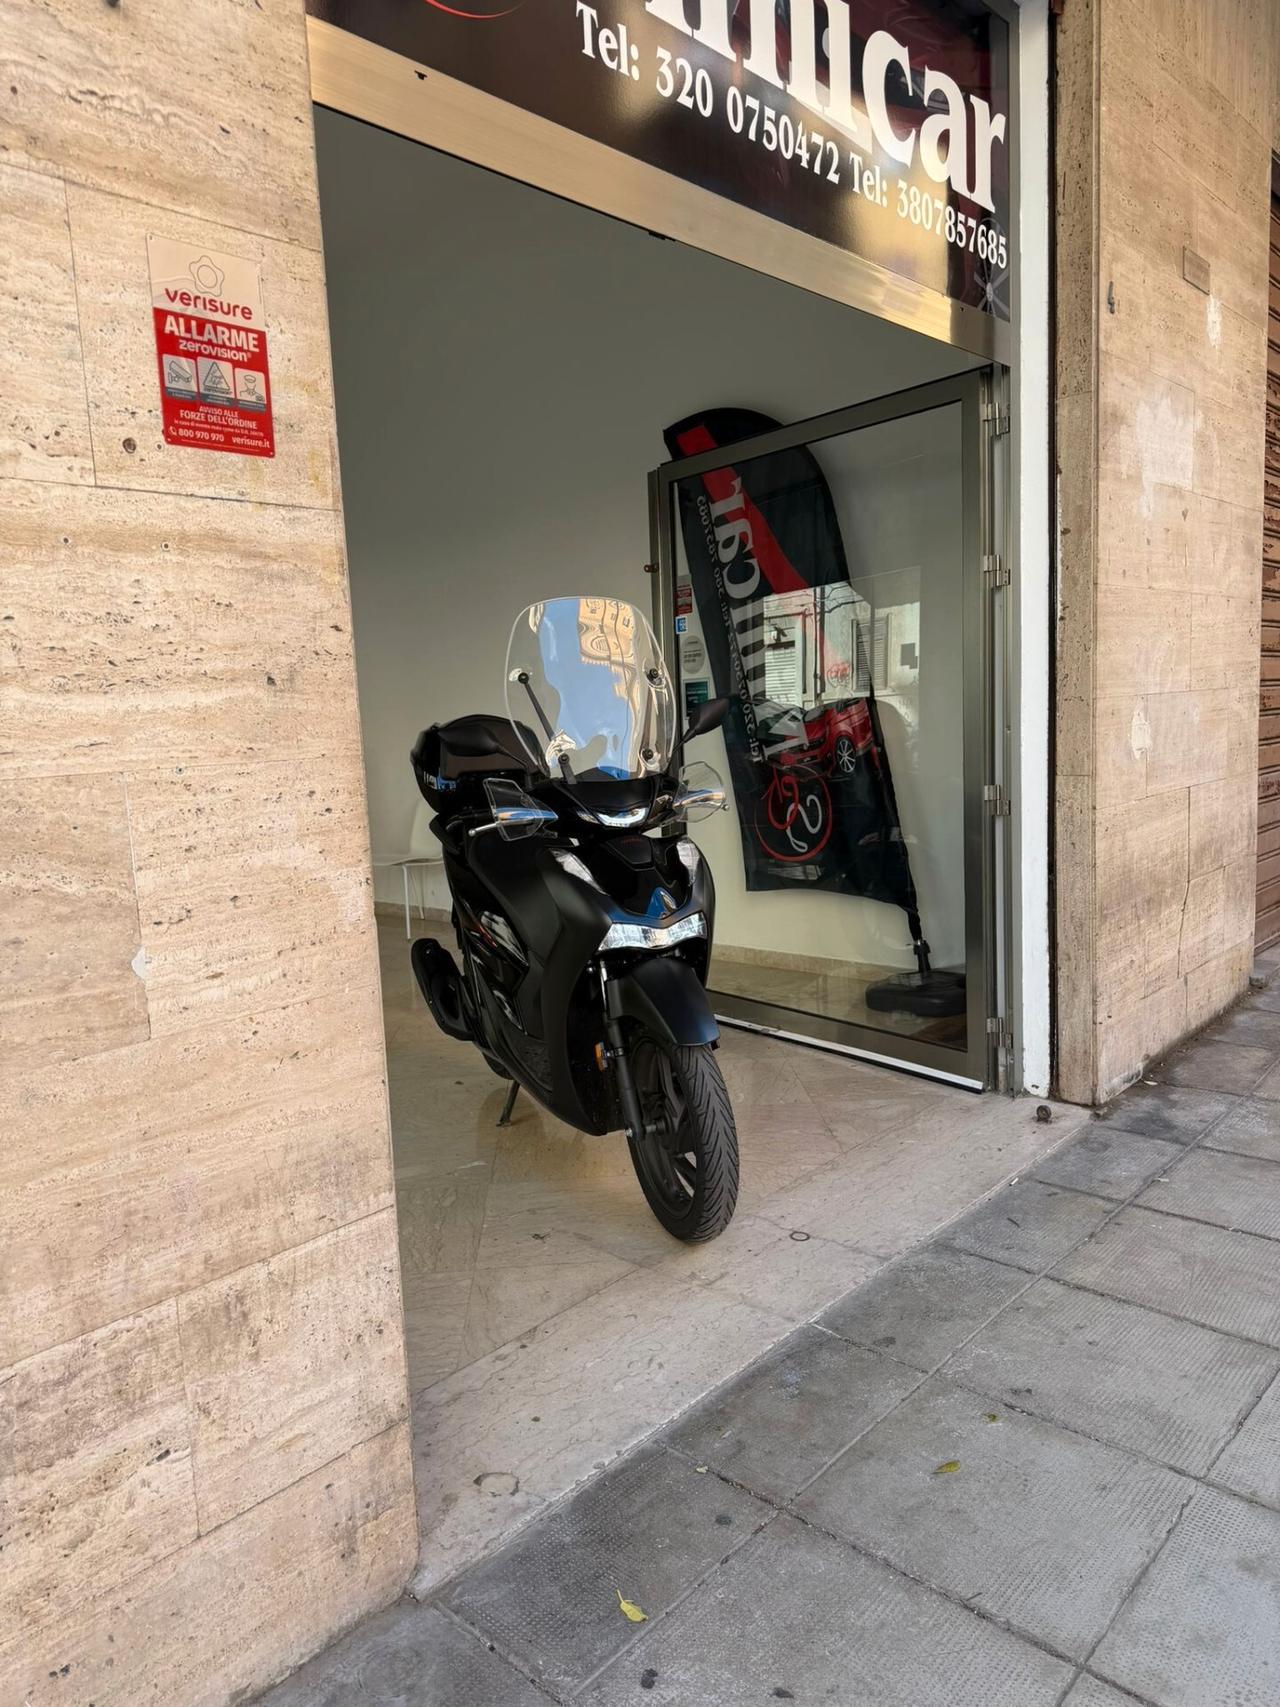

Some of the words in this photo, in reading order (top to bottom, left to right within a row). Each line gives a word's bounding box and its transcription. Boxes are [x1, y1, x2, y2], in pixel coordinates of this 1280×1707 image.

[576, 1, 640, 81] Tel:
[656, 46, 713, 118] 320
[727, 85, 841, 185] 0750472
[848, 153, 888, 208] Tel:
[896, 179, 1008, 269] 3807857685
[164, 287, 253, 321] verisure
[164, 315, 260, 353] ALLARME
[180, 409, 207, 422] FORZE
[207, 413, 258, 430] DELL'ORDINE
[199, 406, 223, 415] AVVISO
[223, 409, 239, 418] ALLE
[178, 428, 194, 438] 800
[195, 430, 210, 441] 970
[210, 433, 225, 443] 970
[231, 435, 271, 448] verisure.it
